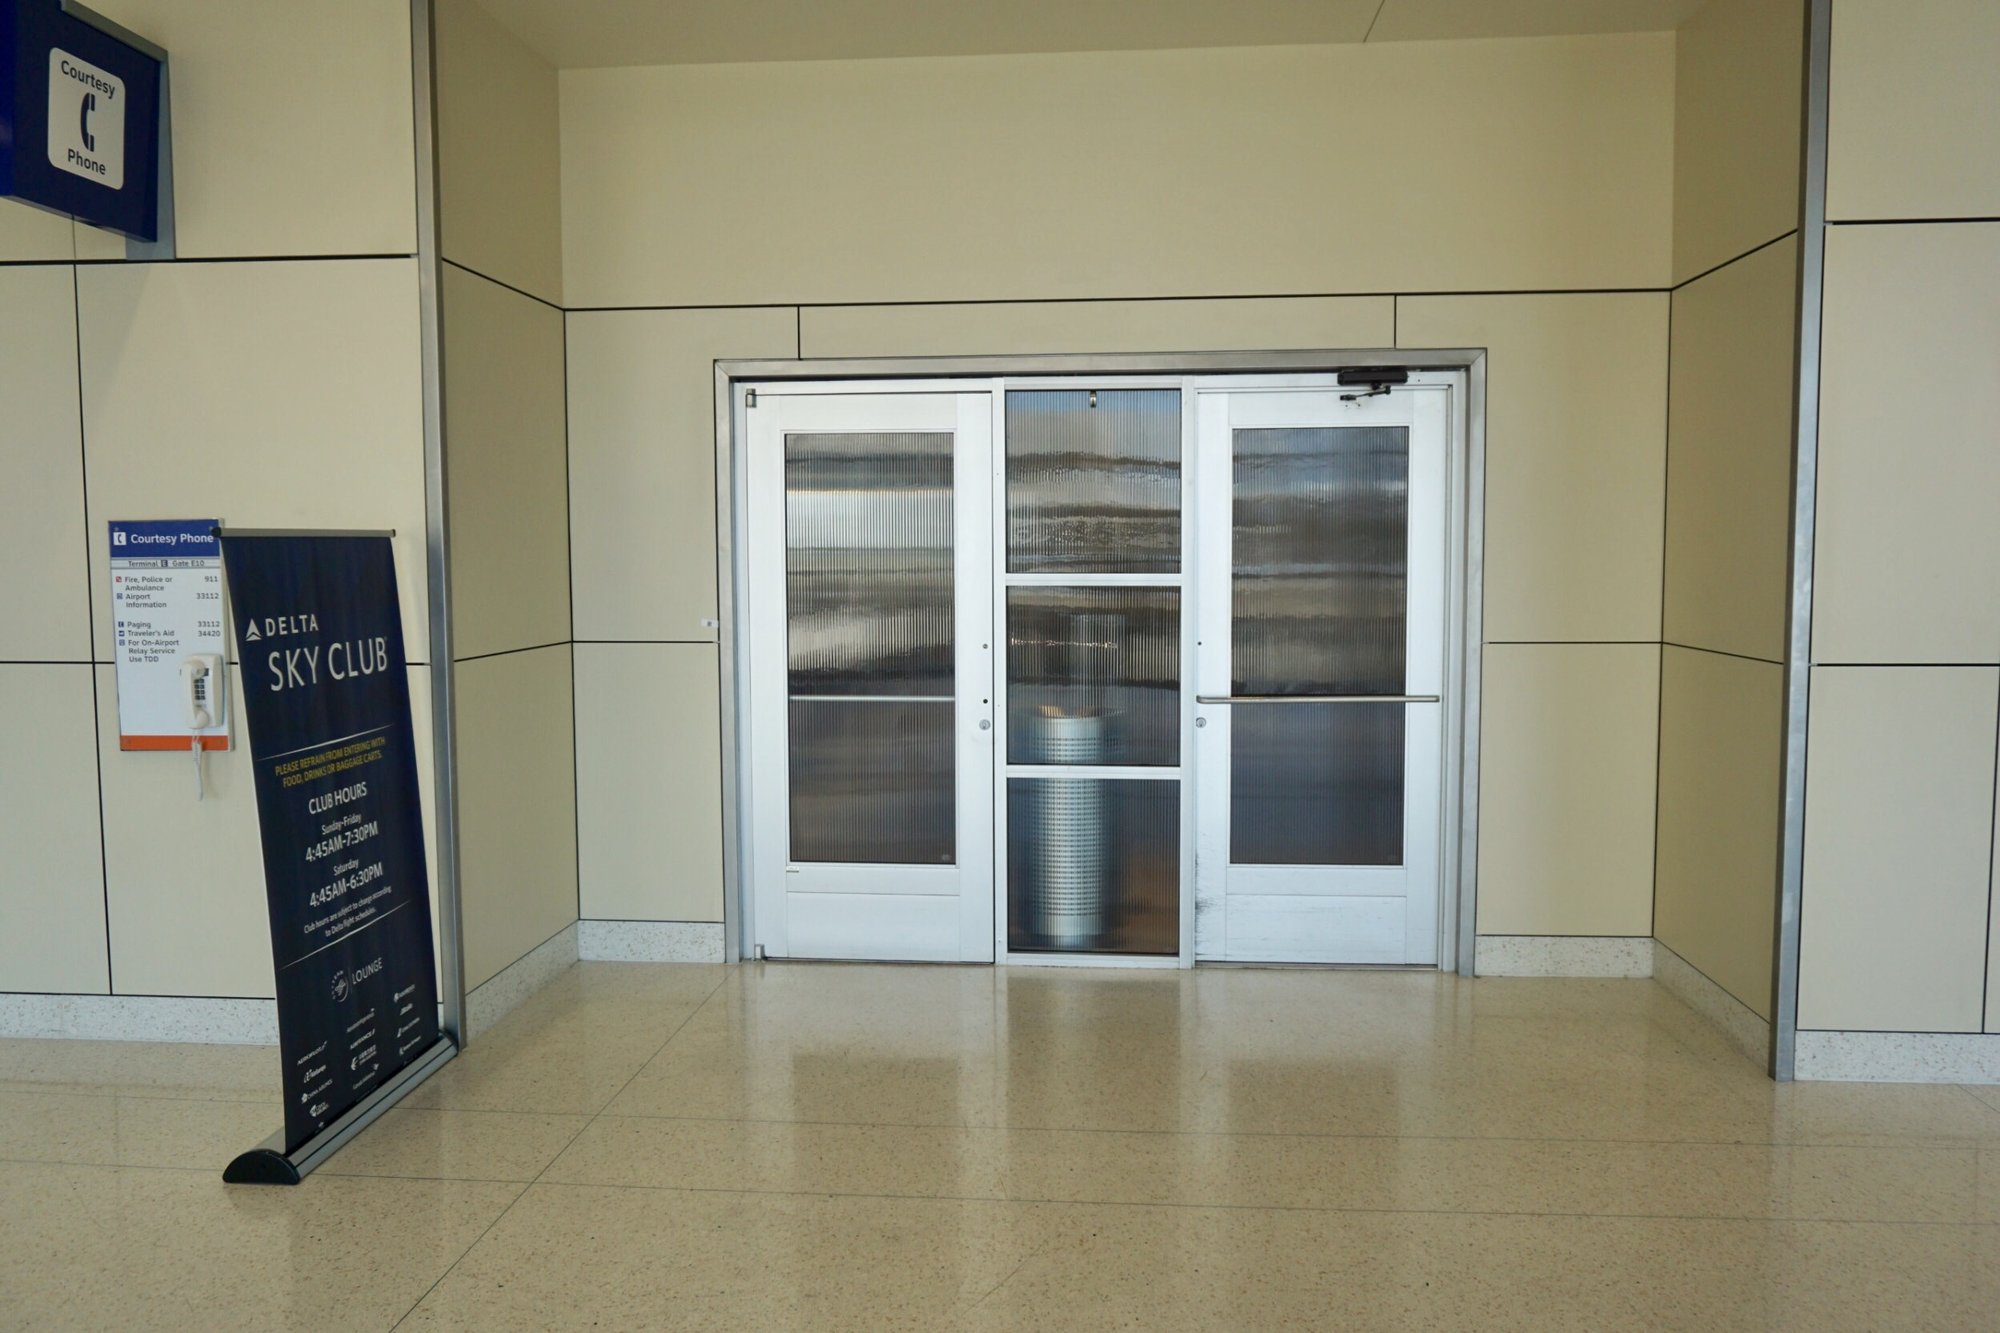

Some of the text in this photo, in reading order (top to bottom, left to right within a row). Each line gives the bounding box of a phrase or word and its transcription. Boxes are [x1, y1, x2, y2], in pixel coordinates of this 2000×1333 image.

[61, 60, 115, 99] Courtesy
[68, 148, 106, 175] Phone
[131, 534, 214, 545] Courtesy Phone
[265, 614, 319, 636] DELTA
[268, 637, 388, 691] SKY CLUB
[275, 737, 385, 776] PLEASE REFRAIN FROM ENTERING WITH
[283, 774, 304, 788] FOOD,
[304, 766, 327, 781] DRINKS
[327, 763, 335, 774] OR
[336, 755, 363, 771] BAGGAGE
[308, 781, 367, 814] CLUB HOURS
[321, 813, 361, 835] Sunday-Friday
[305, 821, 378, 862] 4:45AM-7:30PM
[333, 859, 359, 876] Saturday
[309, 862, 383, 907] 4:45AM-6:30PM
[304, 922, 315, 934] Club
[315, 917, 329, 928] hours
[329, 913, 337, 921] are
[337, 904, 352, 918] subject
[357, 895, 372, 907] change
[331, 923, 343, 934] Delta
[352, 957, 383, 985] LOUNGE
